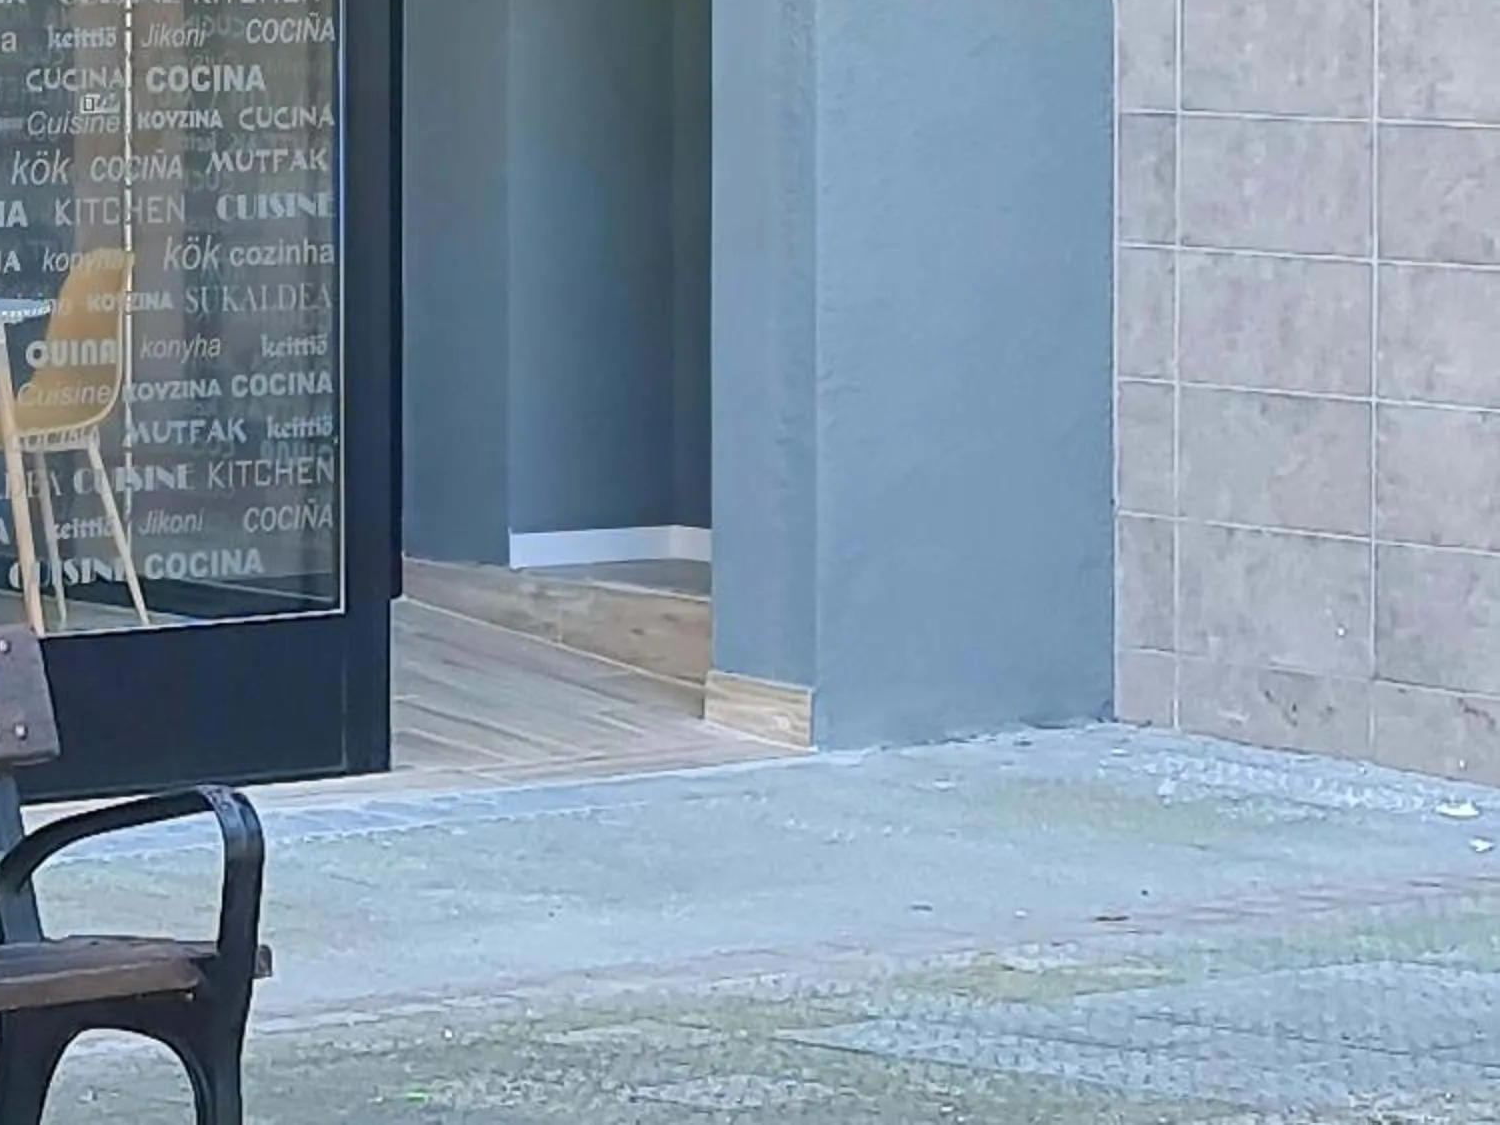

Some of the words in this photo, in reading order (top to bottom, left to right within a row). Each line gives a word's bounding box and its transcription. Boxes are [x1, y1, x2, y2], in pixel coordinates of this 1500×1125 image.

[47, 26, 117, 49] keittiö
[140, 23, 205, 48] Jikoni
[146, 64, 266, 94] COCINA
[239, 107, 336, 131] CUCINA
[11, 150, 73, 186] kök
[205, 149, 329, 176] MUTFAK
[216, 193, 336, 222] CUISINE
[163, 237, 223, 271] kök
[229, 239, 336, 267] cozinha
[184, 284, 332, 313] SUKALDEA
[140, 334, 222, 363] konyha
[261, 332, 329, 359] keittiö
[231, 373, 332, 399] COCINA
[267, 415, 332, 437] keittiö
[208, 458, 334, 488] KITCHEN
[137, 509, 204, 534] Jikoni
[145, 548, 264, 580] COCINA
